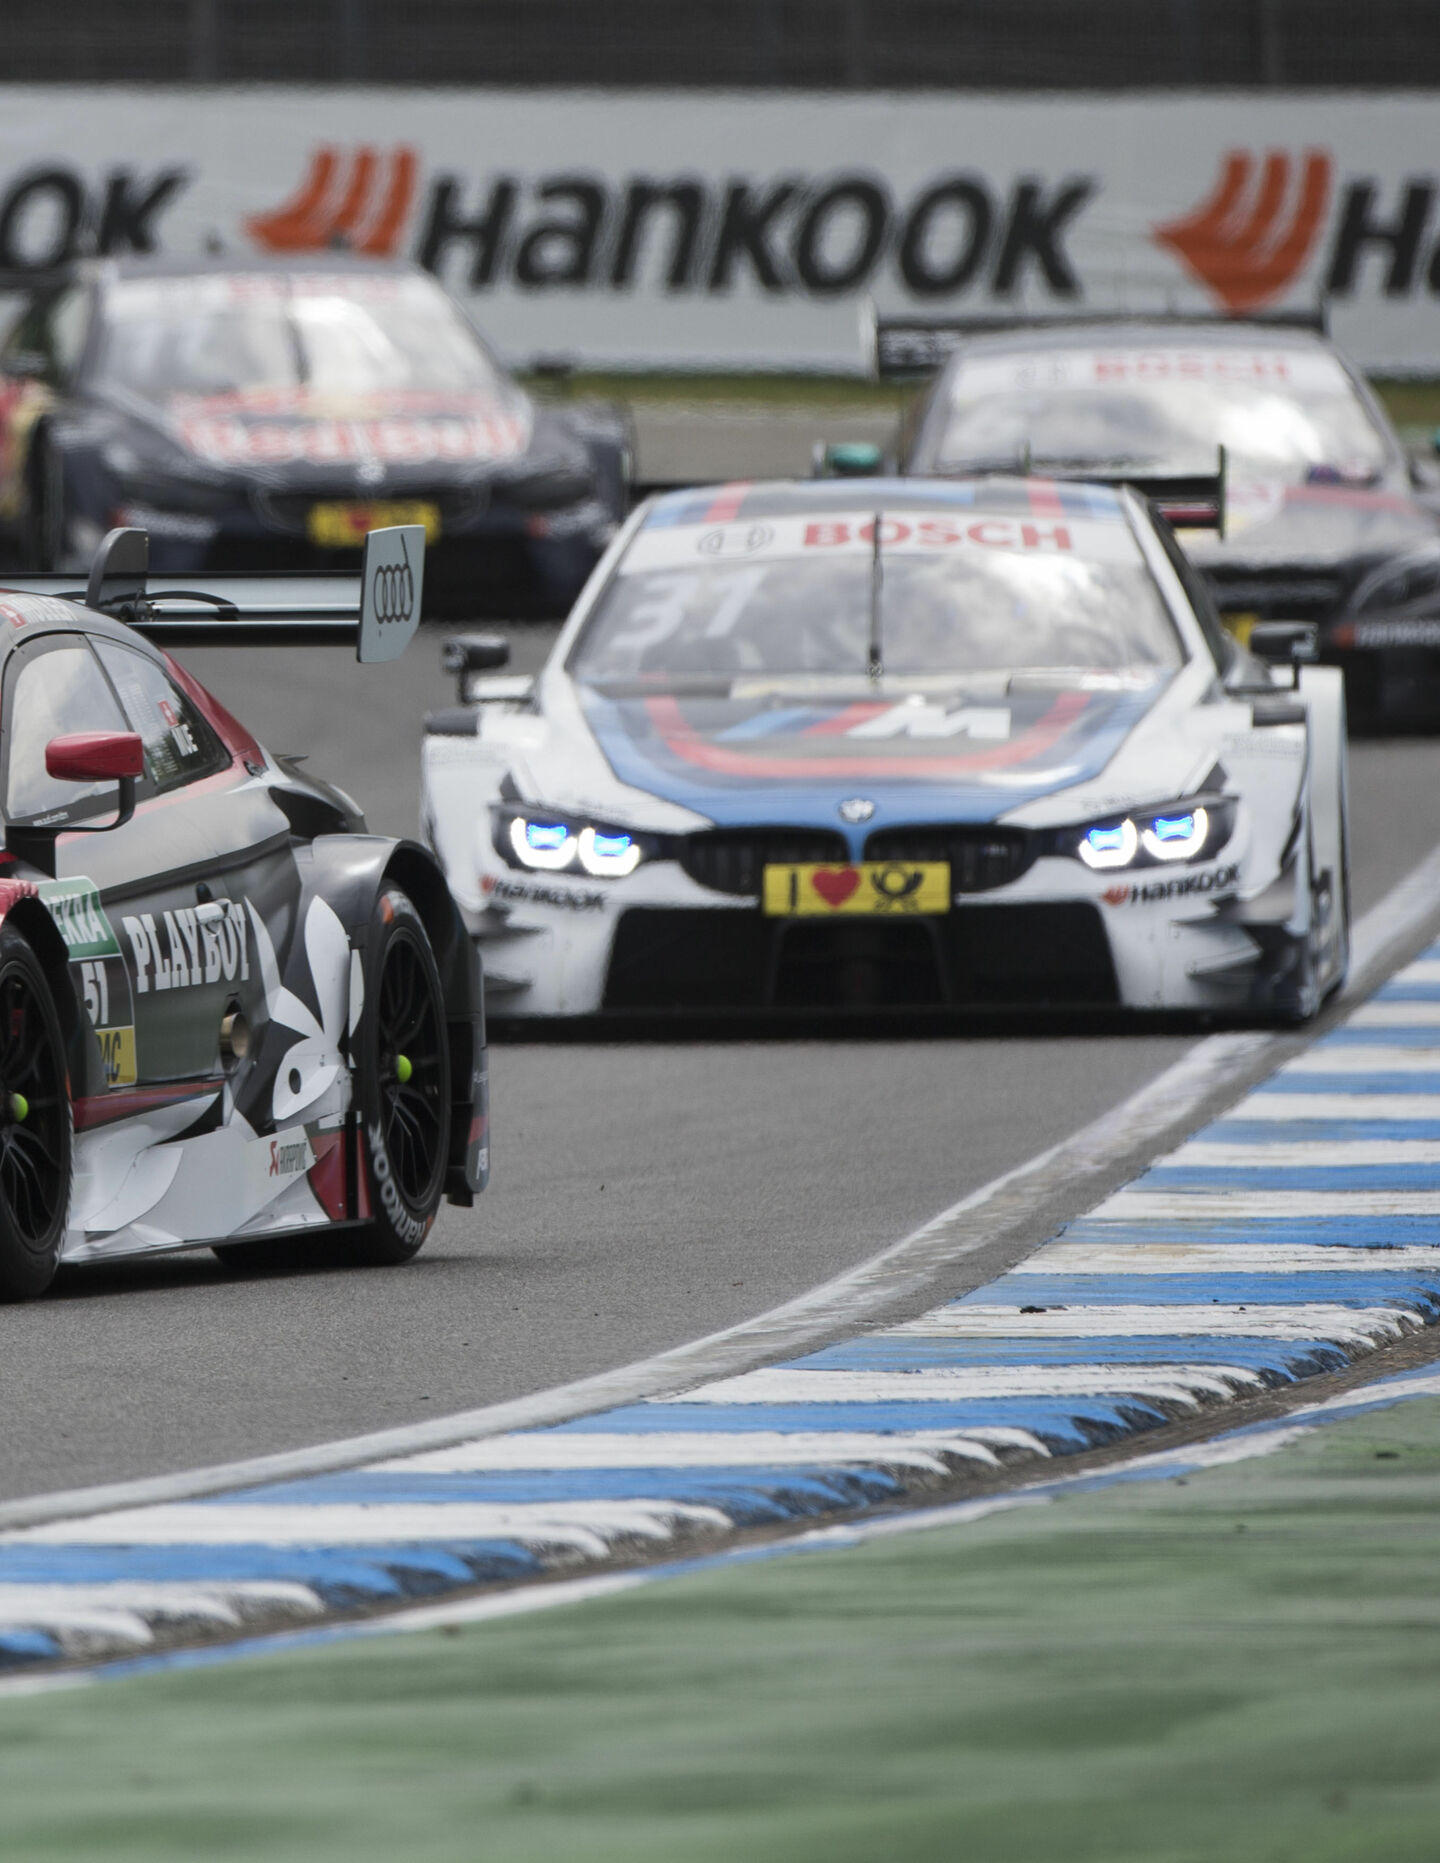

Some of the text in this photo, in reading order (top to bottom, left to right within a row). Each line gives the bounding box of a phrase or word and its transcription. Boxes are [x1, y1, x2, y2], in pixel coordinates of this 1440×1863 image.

[803, 519, 1073, 551] BOSCH
[612, 568, 766, 647] 31
[122, 904, 249, 993] PLAYBOY
[81, 961, 108, 1025] 51
